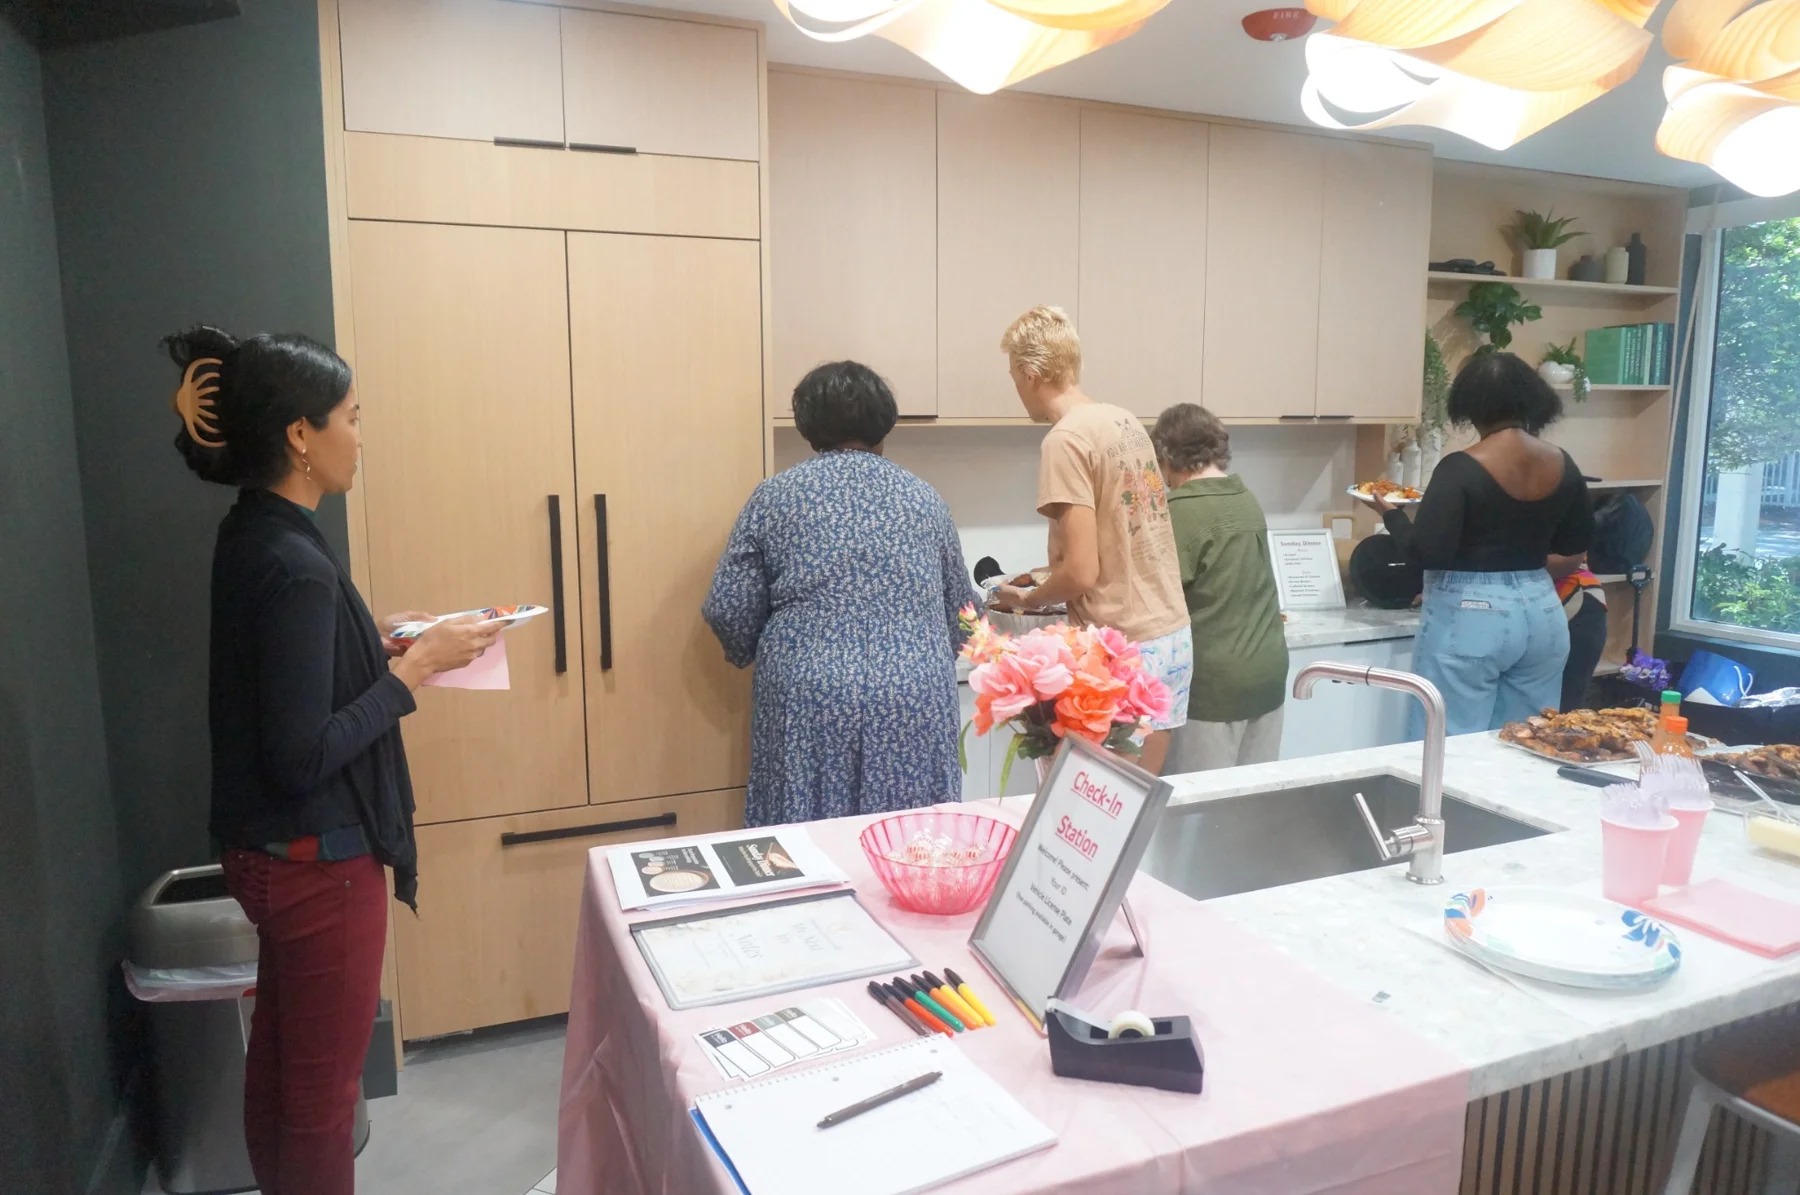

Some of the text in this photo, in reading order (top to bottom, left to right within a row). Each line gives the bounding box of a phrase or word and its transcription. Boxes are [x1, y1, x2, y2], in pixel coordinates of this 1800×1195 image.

[1273, 11, 1299, 19] FIRE
[1073, 771, 1123, 816] Check-In
[1057, 815, 1098, 858] Station
[1057, 859, 1072, 876] Please
[1030, 883, 1072, 926] Vehicle License Plate
